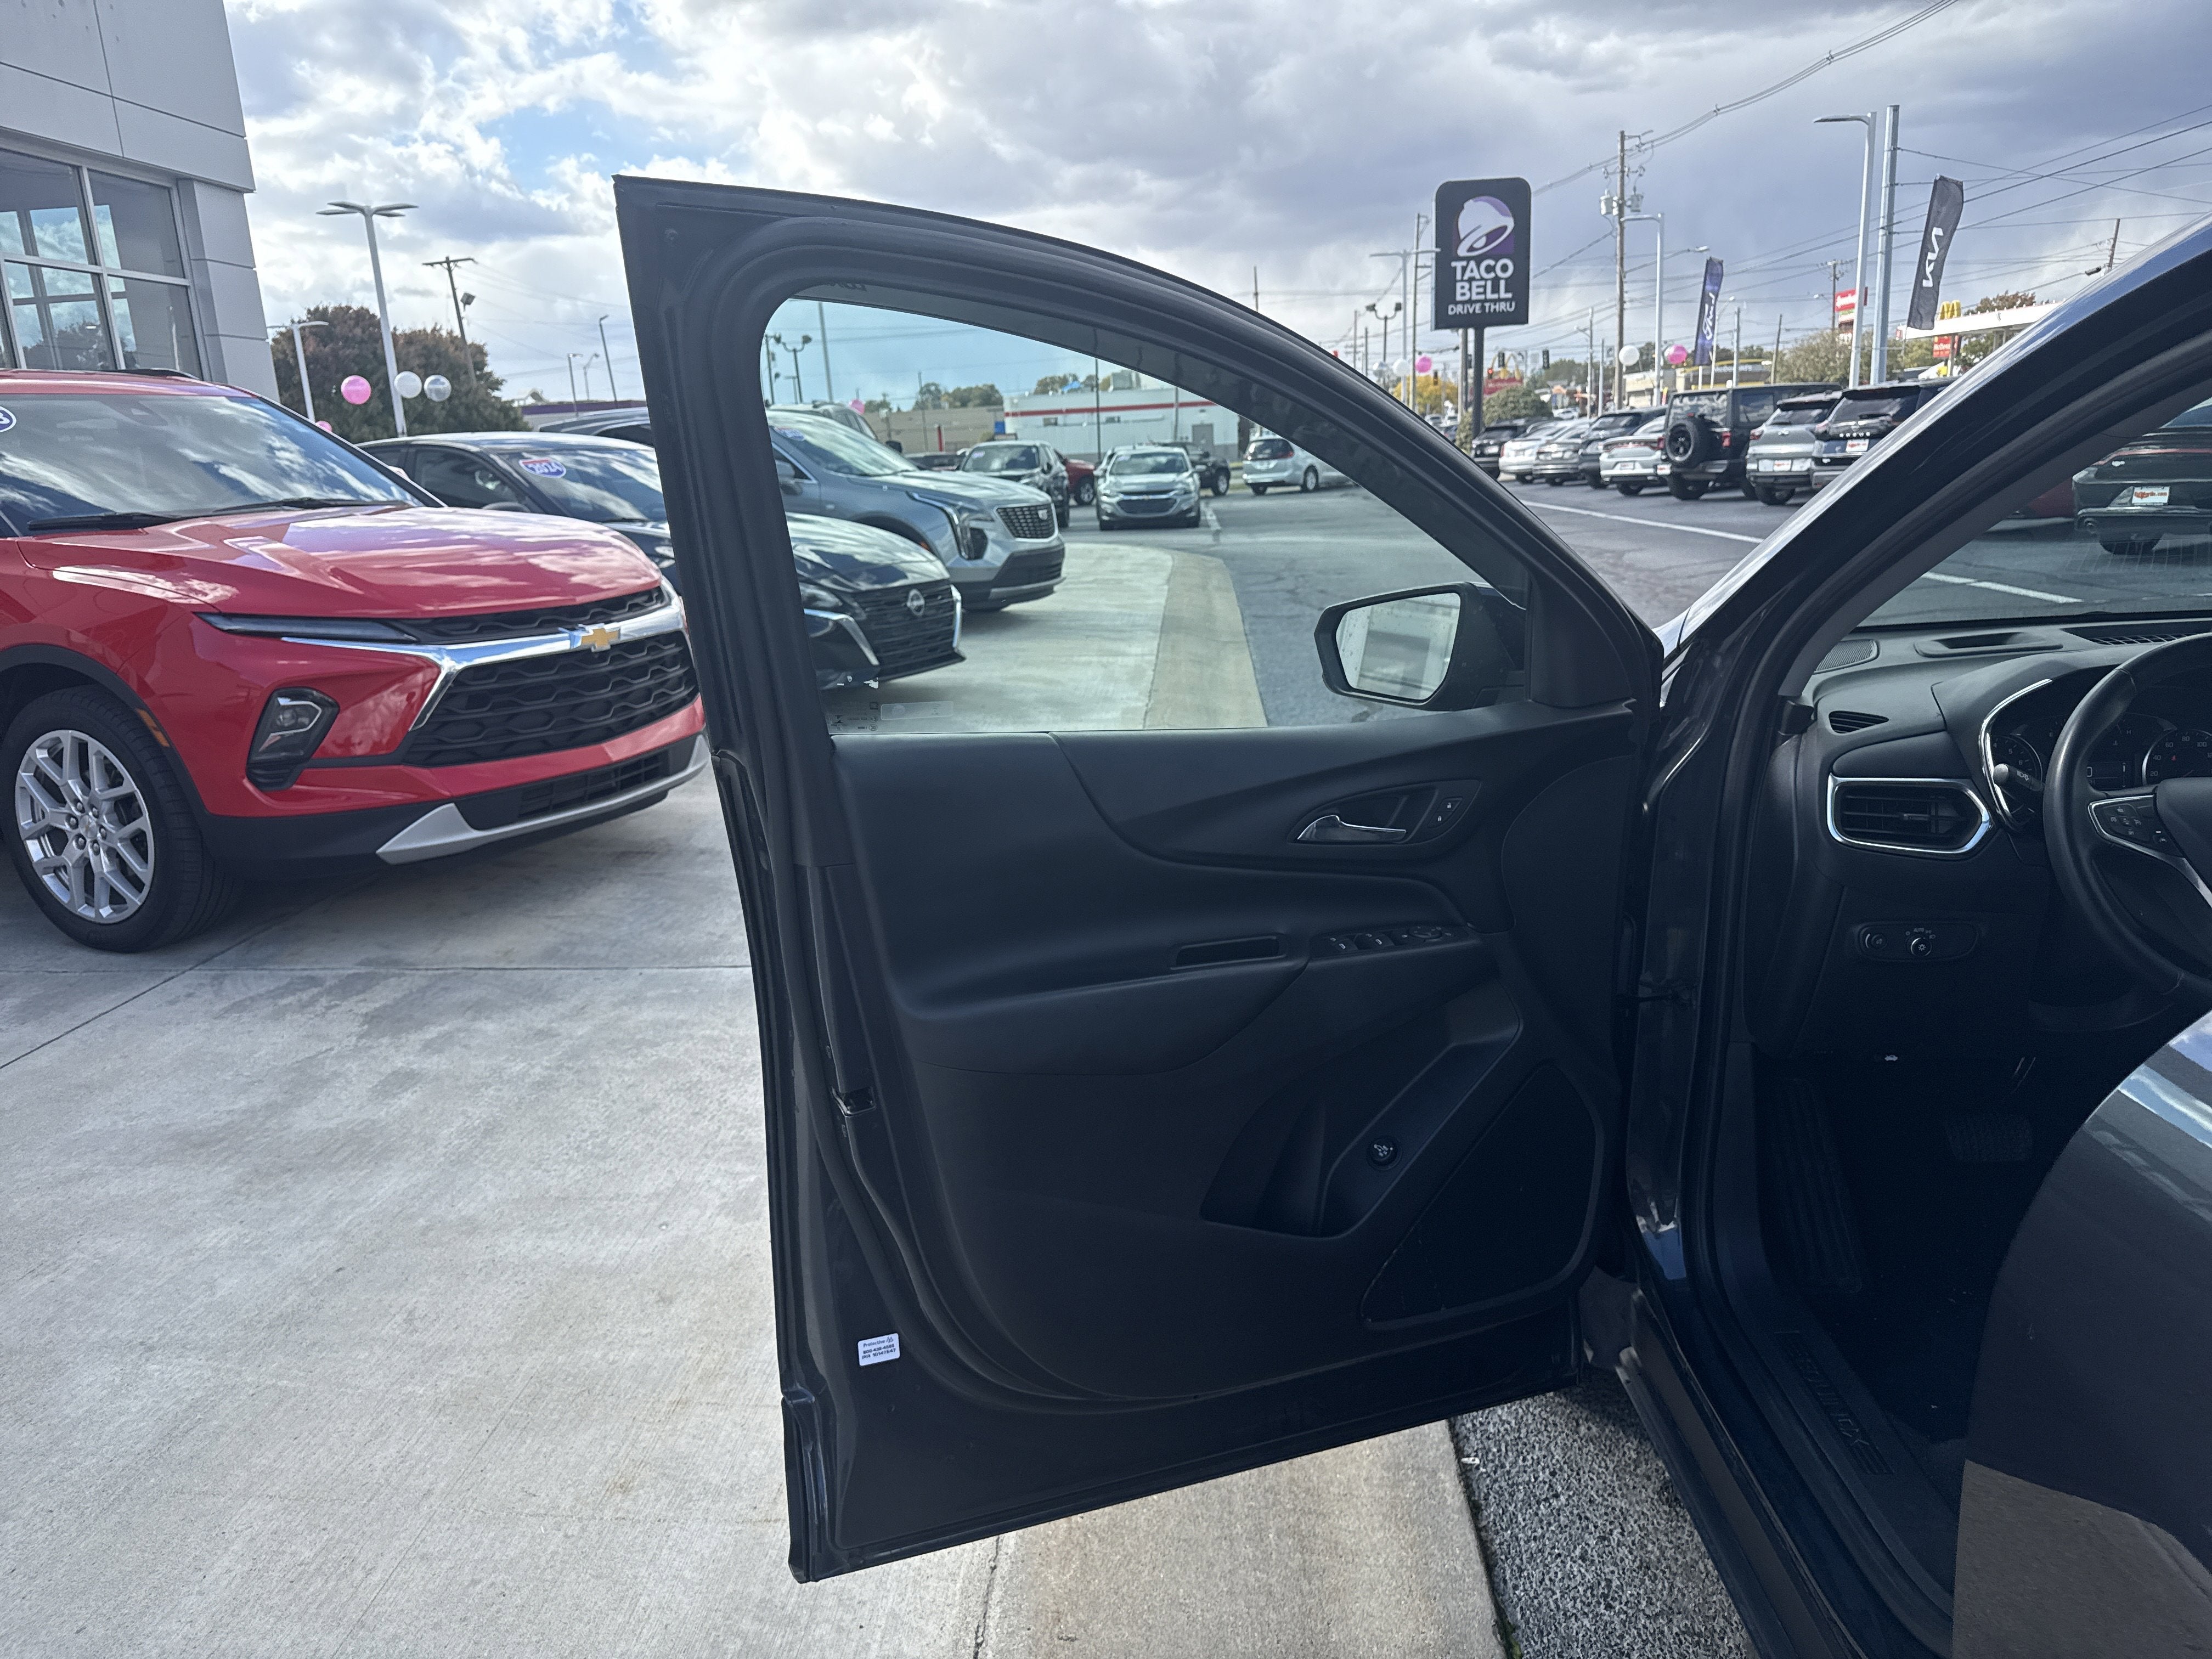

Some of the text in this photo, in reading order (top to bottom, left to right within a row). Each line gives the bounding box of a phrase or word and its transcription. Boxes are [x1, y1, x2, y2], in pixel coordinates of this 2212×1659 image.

[1451, 258, 1514, 280] TACO
[1455, 279, 1513, 301] BELL
[1448, 301, 1516, 315] DRIVE THRU
